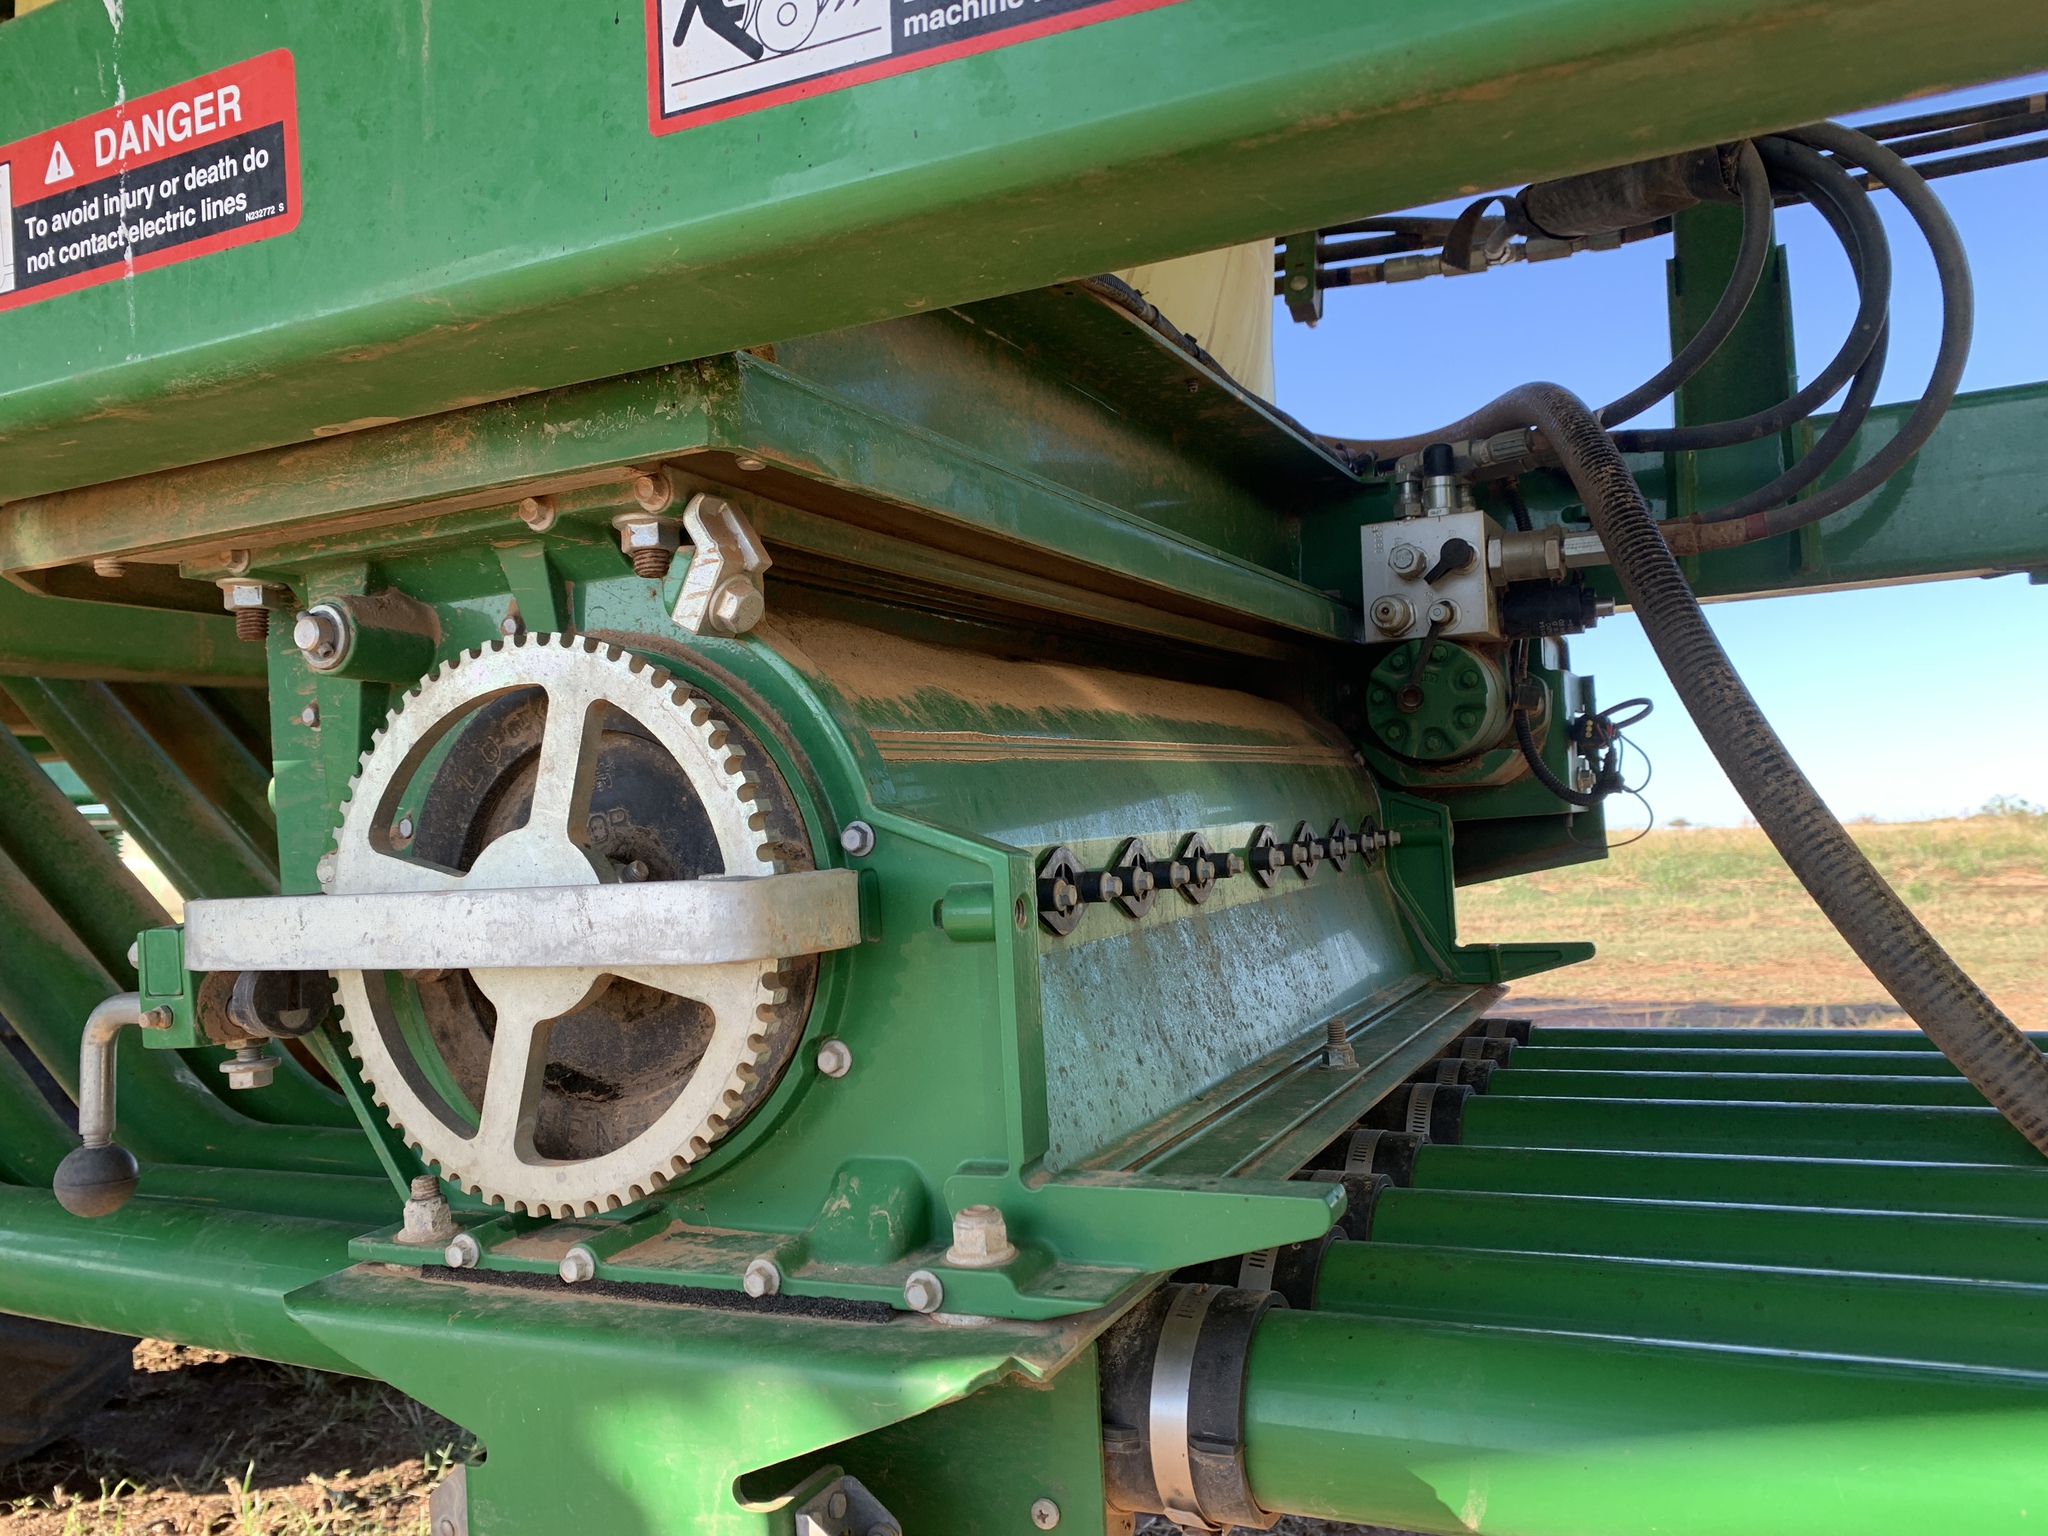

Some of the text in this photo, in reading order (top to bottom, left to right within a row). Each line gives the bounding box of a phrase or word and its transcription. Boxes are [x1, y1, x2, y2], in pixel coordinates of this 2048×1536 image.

[94, 84, 242, 168] DANGER
[24, 147, 269, 240] To avoid injury or death do
[27, 192, 248, 273] not contact electric lines
[245, 202, 285, 222] N232772 S
